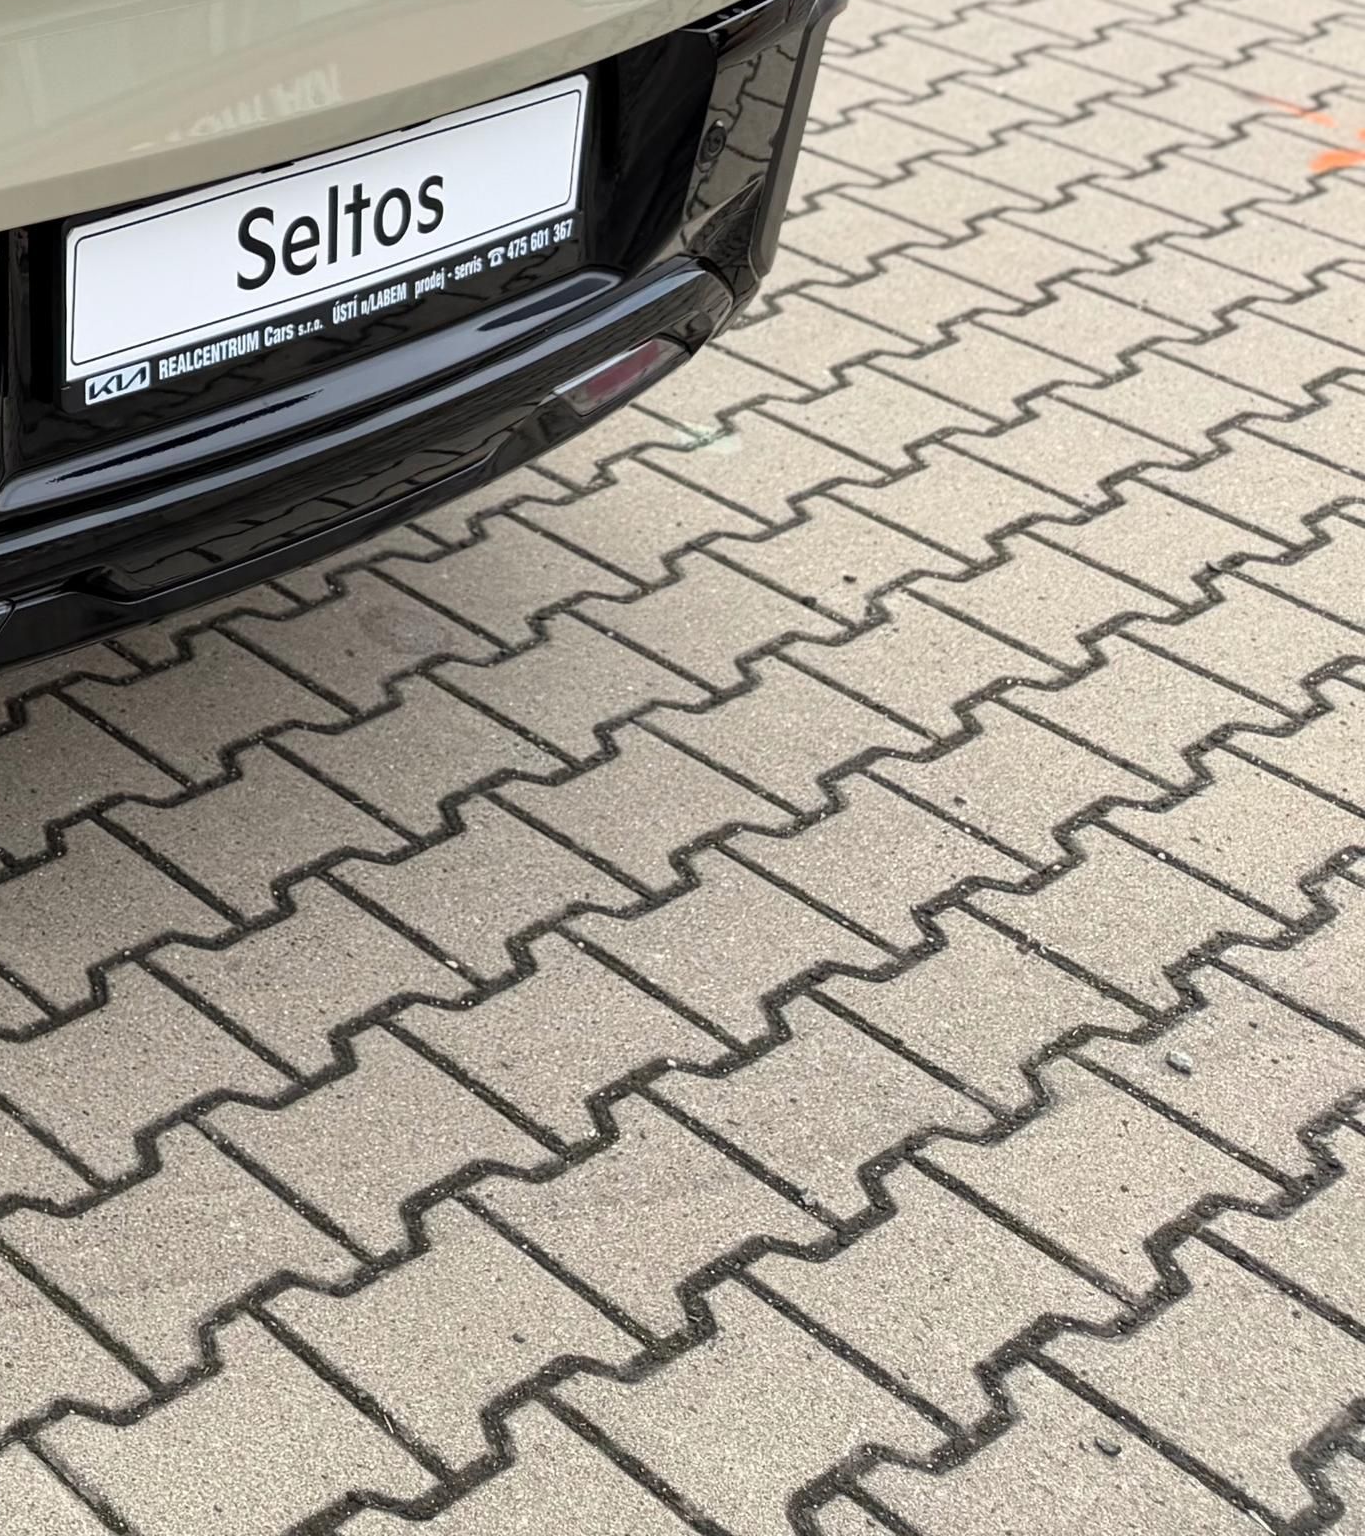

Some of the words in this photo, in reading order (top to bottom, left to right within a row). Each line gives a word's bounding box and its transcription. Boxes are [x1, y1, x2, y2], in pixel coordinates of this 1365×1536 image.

[236, 174, 445, 291] Seltos
[158, 330, 260, 380] REALCENTRUM
[264, 322, 294, 347] Cars
[297, 319, 324, 337] s.r.o.
[332, 288, 358, 325] ÚSTÍ
[360, 282, 407, 315] n/LABEM
[414, 266, 446, 299] prodej
[454, 256, 483, 281] servis
[506, 239, 528, 261] 475
[530, 228, 550, 252] 601
[553, 218, 574, 243] 367
[88, 365, 147, 401] KIA
